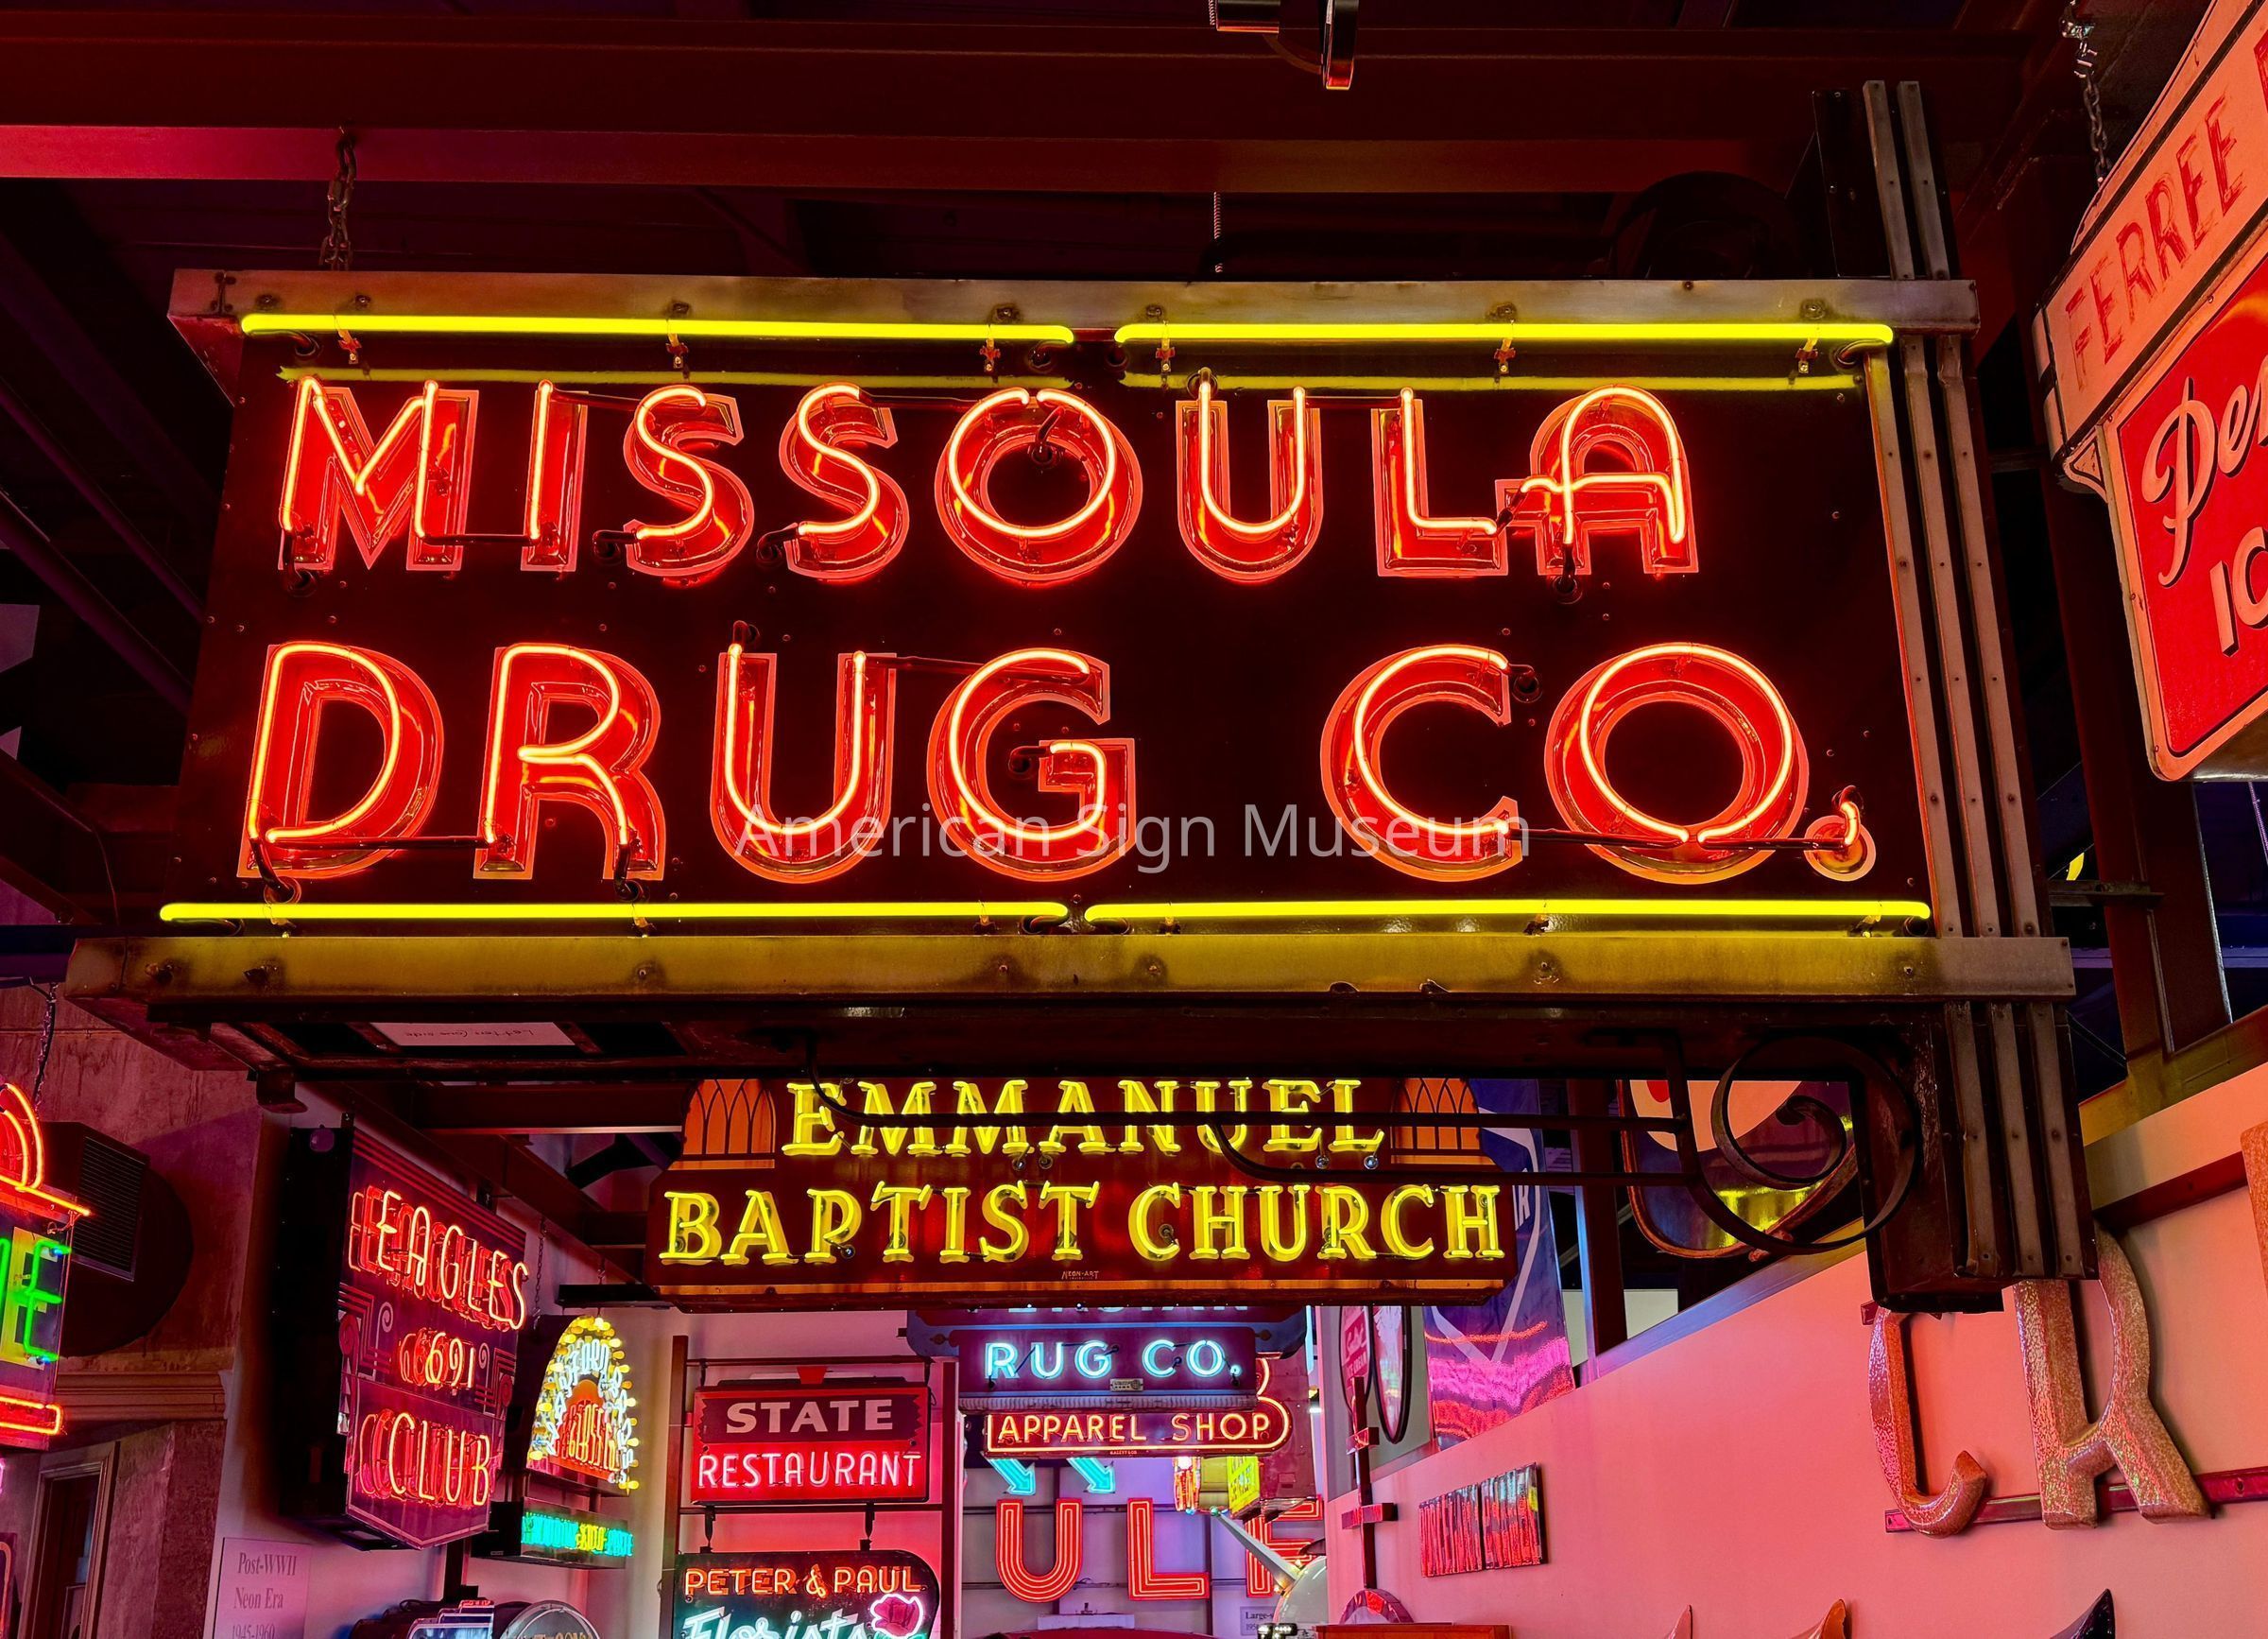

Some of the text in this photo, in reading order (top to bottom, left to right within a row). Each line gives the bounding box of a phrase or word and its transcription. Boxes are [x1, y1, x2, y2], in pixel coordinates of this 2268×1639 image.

[278, 378, 1699, 582] MISSOULA
[237, 639, 1876, 885] DRUG CO.
[782, 1078, 1385, 1156] EMMANUEL
[659, 1180, 1101, 1265] BAPTIST
[1126, 1182, 1505, 1262] CHURCH
[355, 1185, 528, 1331] EAGLES
[409, 1329, 474, 1391] 691
[985, 1338, 1243, 1379] RUG CO.
[725, 1399, 894, 1433] STATE
[998, 1411, 1271, 1443] APPAREL SHOP
[362, 1410, 492, 1509] CLUB
[698, 1450, 922, 1489] RESTAURANT
[238, 1552, 297, 1576] Post-WWII
[684, 1563, 924, 1598] PETER & PAUL
[234, 1587, 284, 1609] Neon Era
